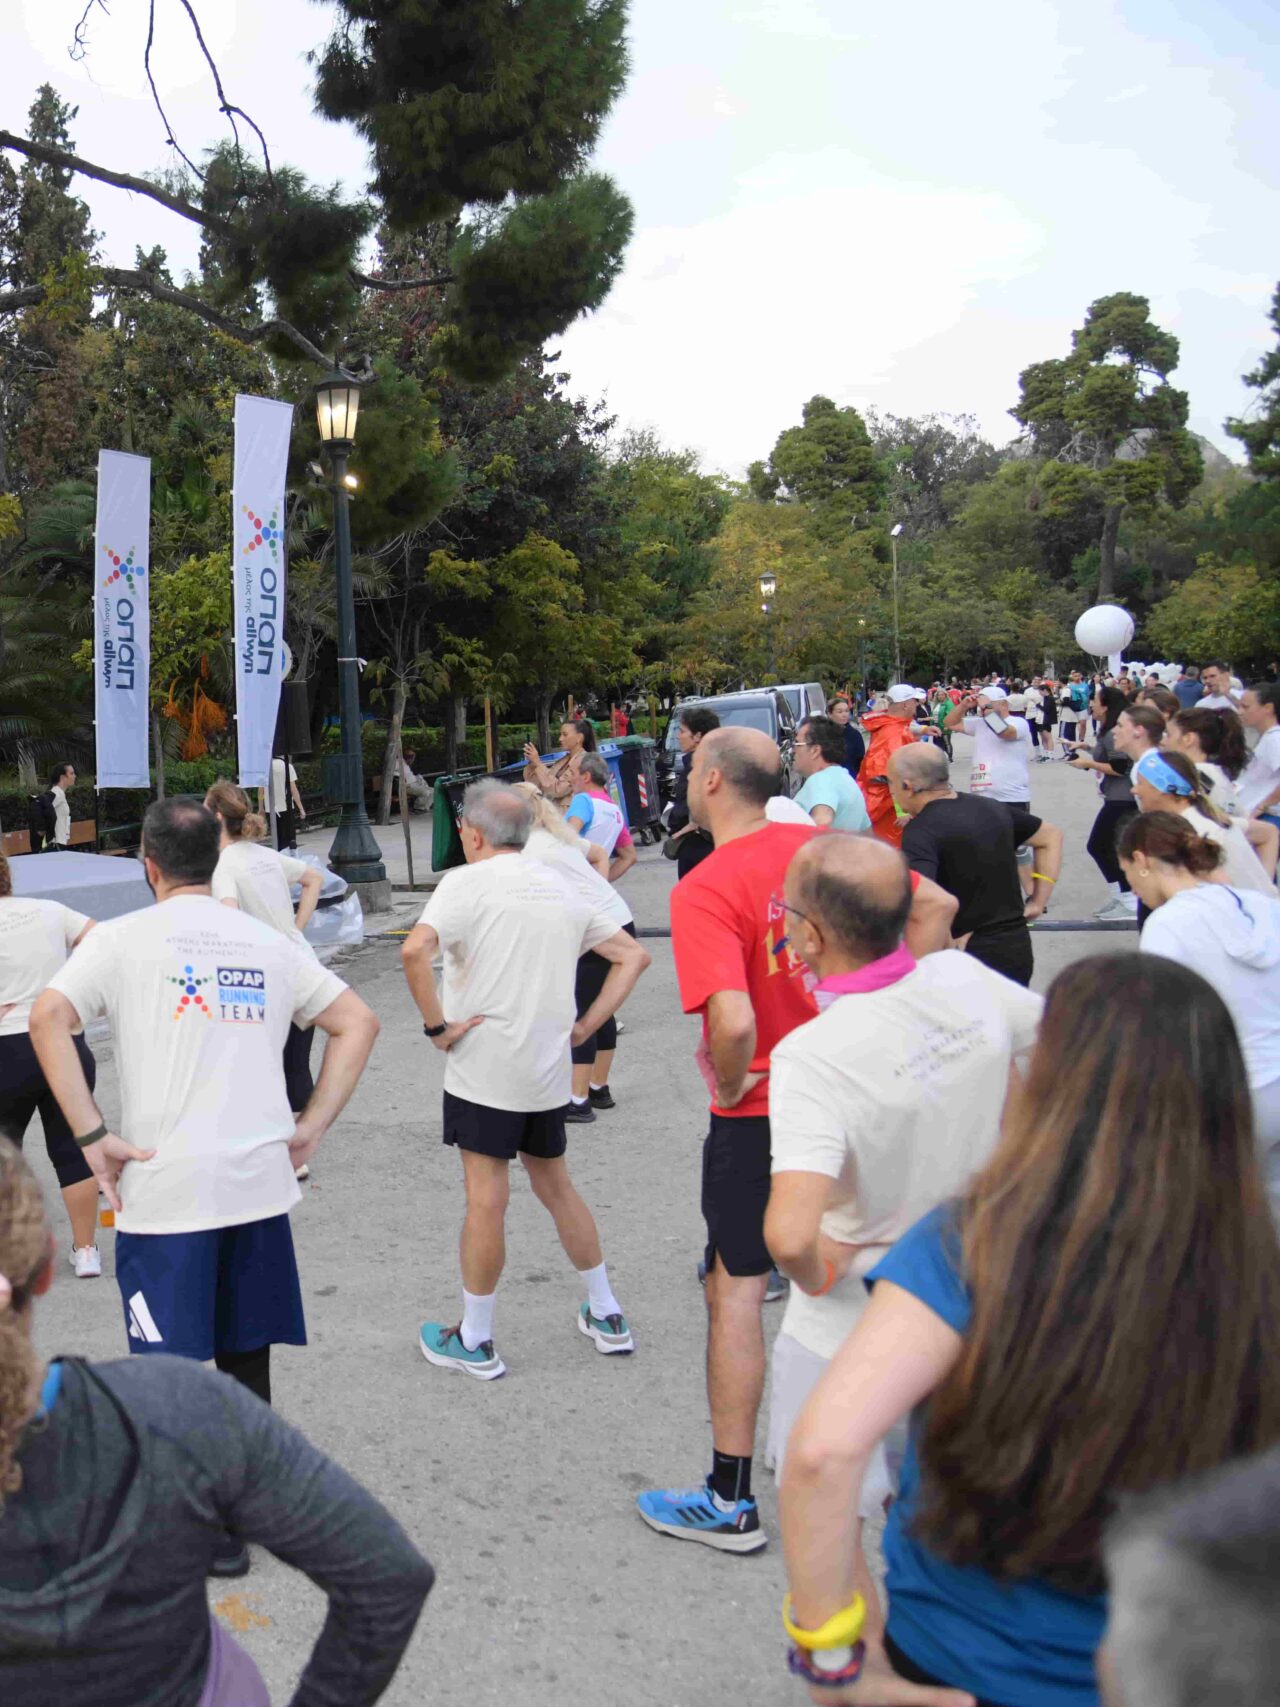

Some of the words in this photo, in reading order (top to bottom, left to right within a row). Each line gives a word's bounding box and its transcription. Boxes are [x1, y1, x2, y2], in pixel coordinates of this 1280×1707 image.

[242, 616, 257, 674] allwyn
[102, 640, 116, 689] allwyn
[218, 969, 264, 987] OPAP
[219, 988, 266, 1005] RUNNING
[220, 1004, 265, 1021] TEAM
